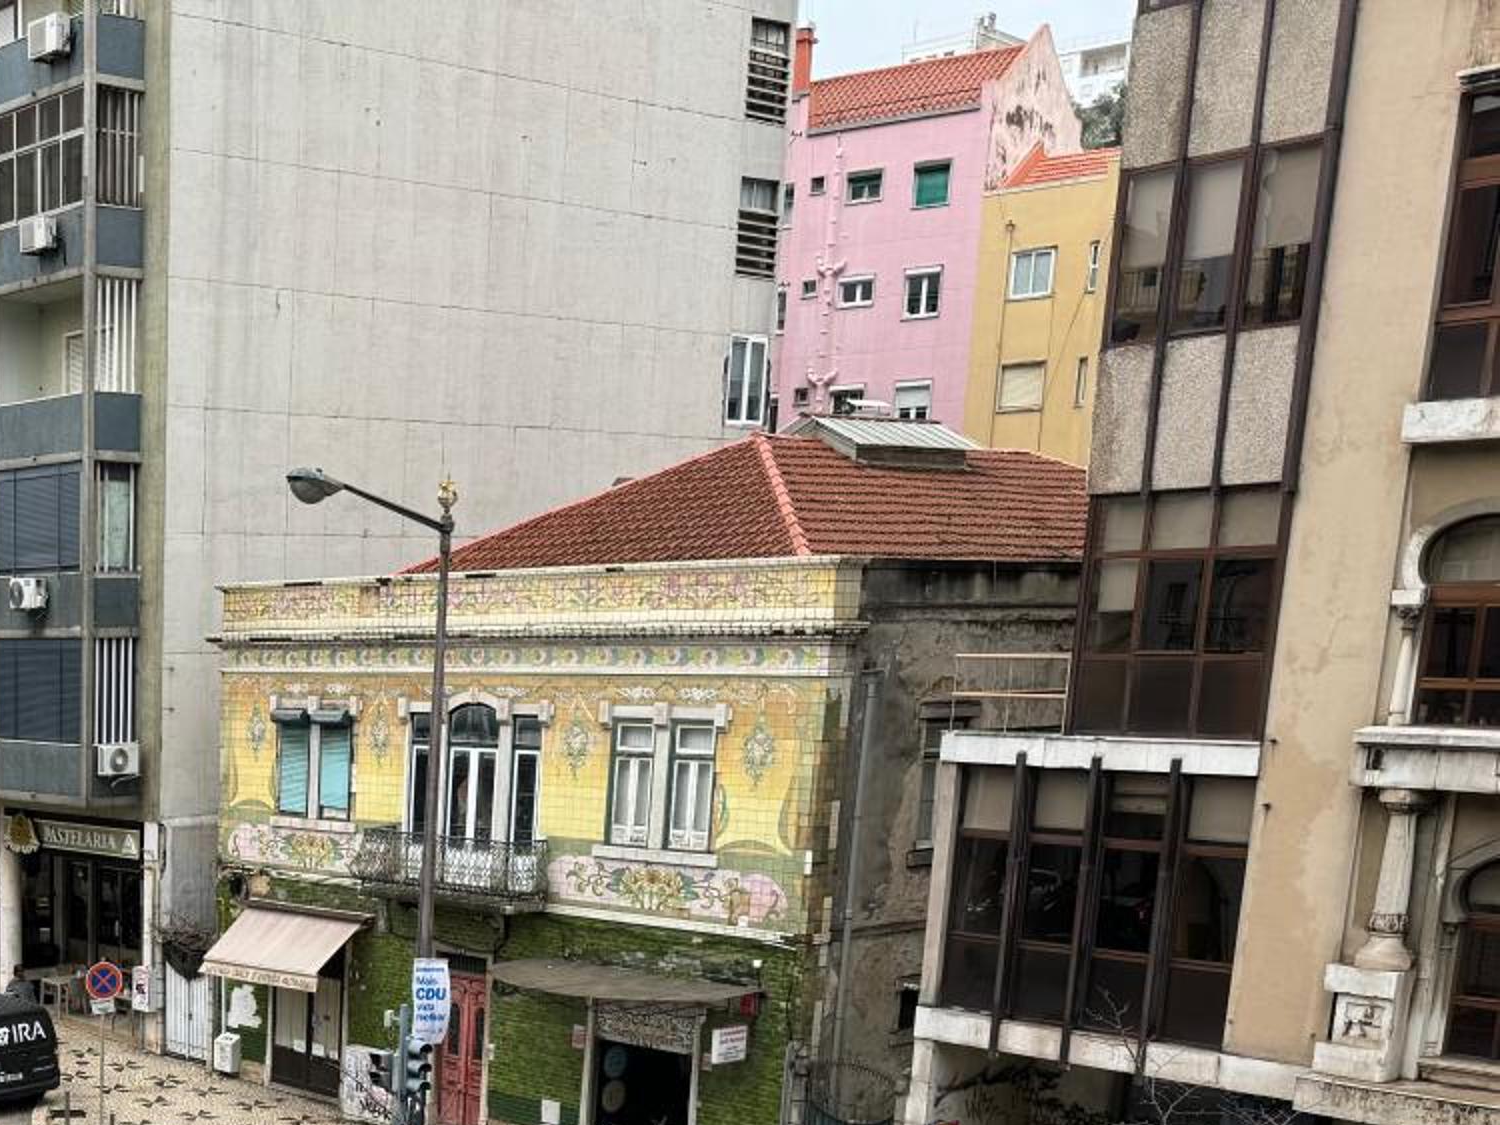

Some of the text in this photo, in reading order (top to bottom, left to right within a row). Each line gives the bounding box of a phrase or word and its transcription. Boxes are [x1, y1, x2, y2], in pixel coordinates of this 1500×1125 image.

[43, 824, 117, 850] PASTELARIA
[416, 987, 447, 1000] CDU
[12, 1020, 47, 1044] IRA
